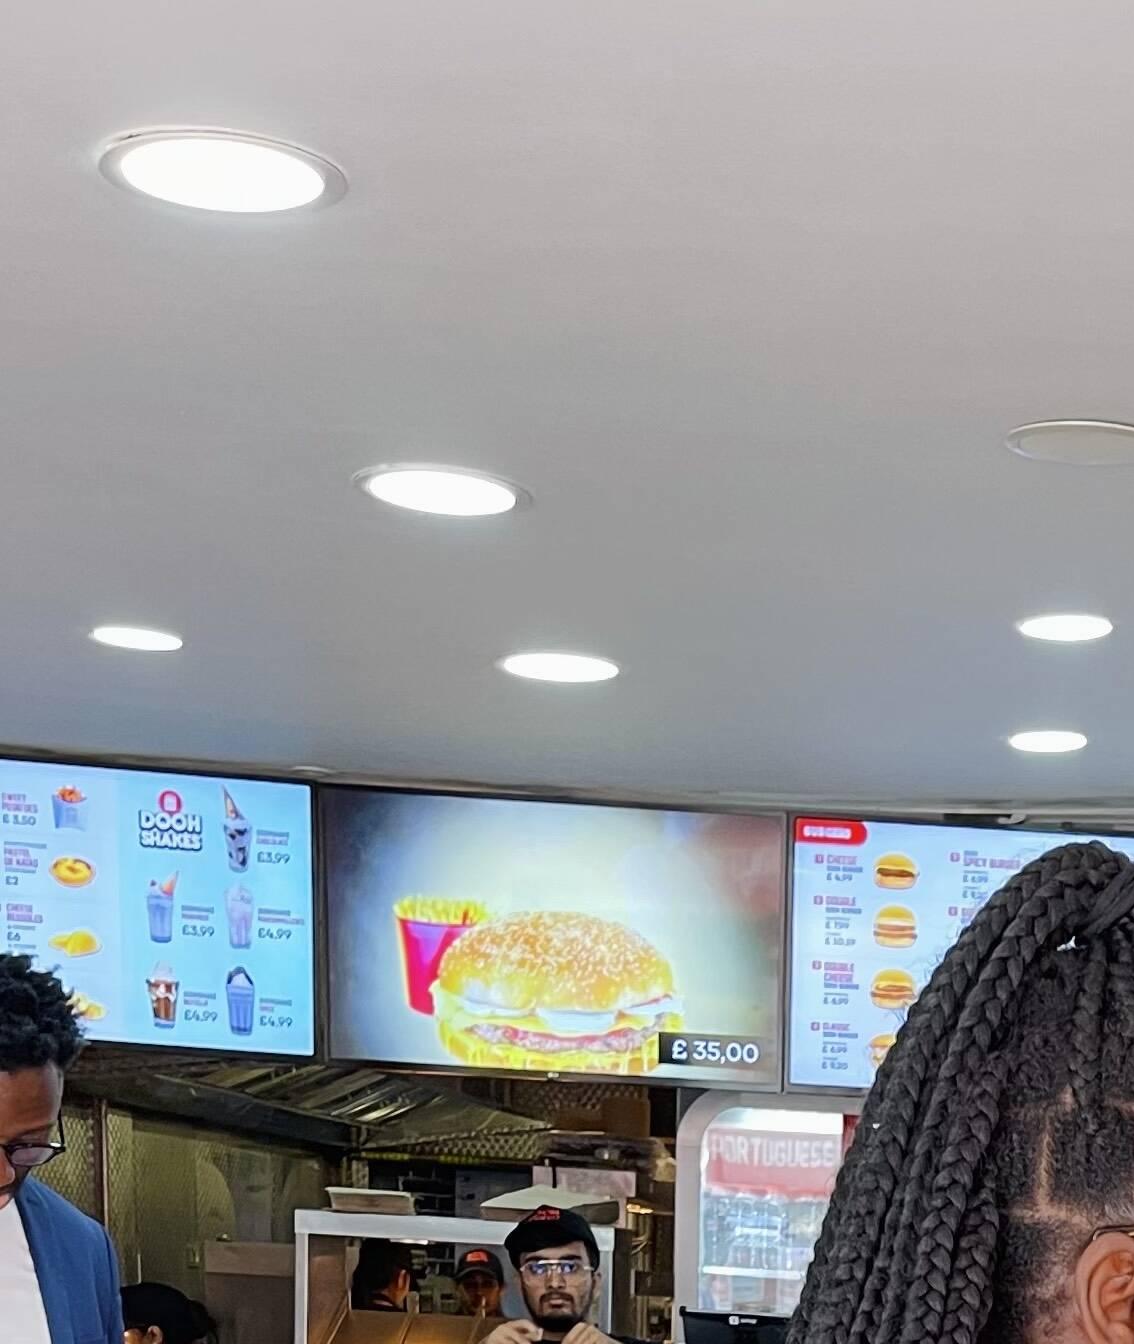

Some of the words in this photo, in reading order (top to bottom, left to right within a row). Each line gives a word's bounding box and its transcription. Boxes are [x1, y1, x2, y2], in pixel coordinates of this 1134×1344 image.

[139, 811, 202, 833] DOOH
[139, 830, 202, 850] SHAKES
[671, 1039, 688, 1060] £
[692, 1040, 760, 1064] 35,00
[710, 1133, 834, 1169] PORTUGUESE
